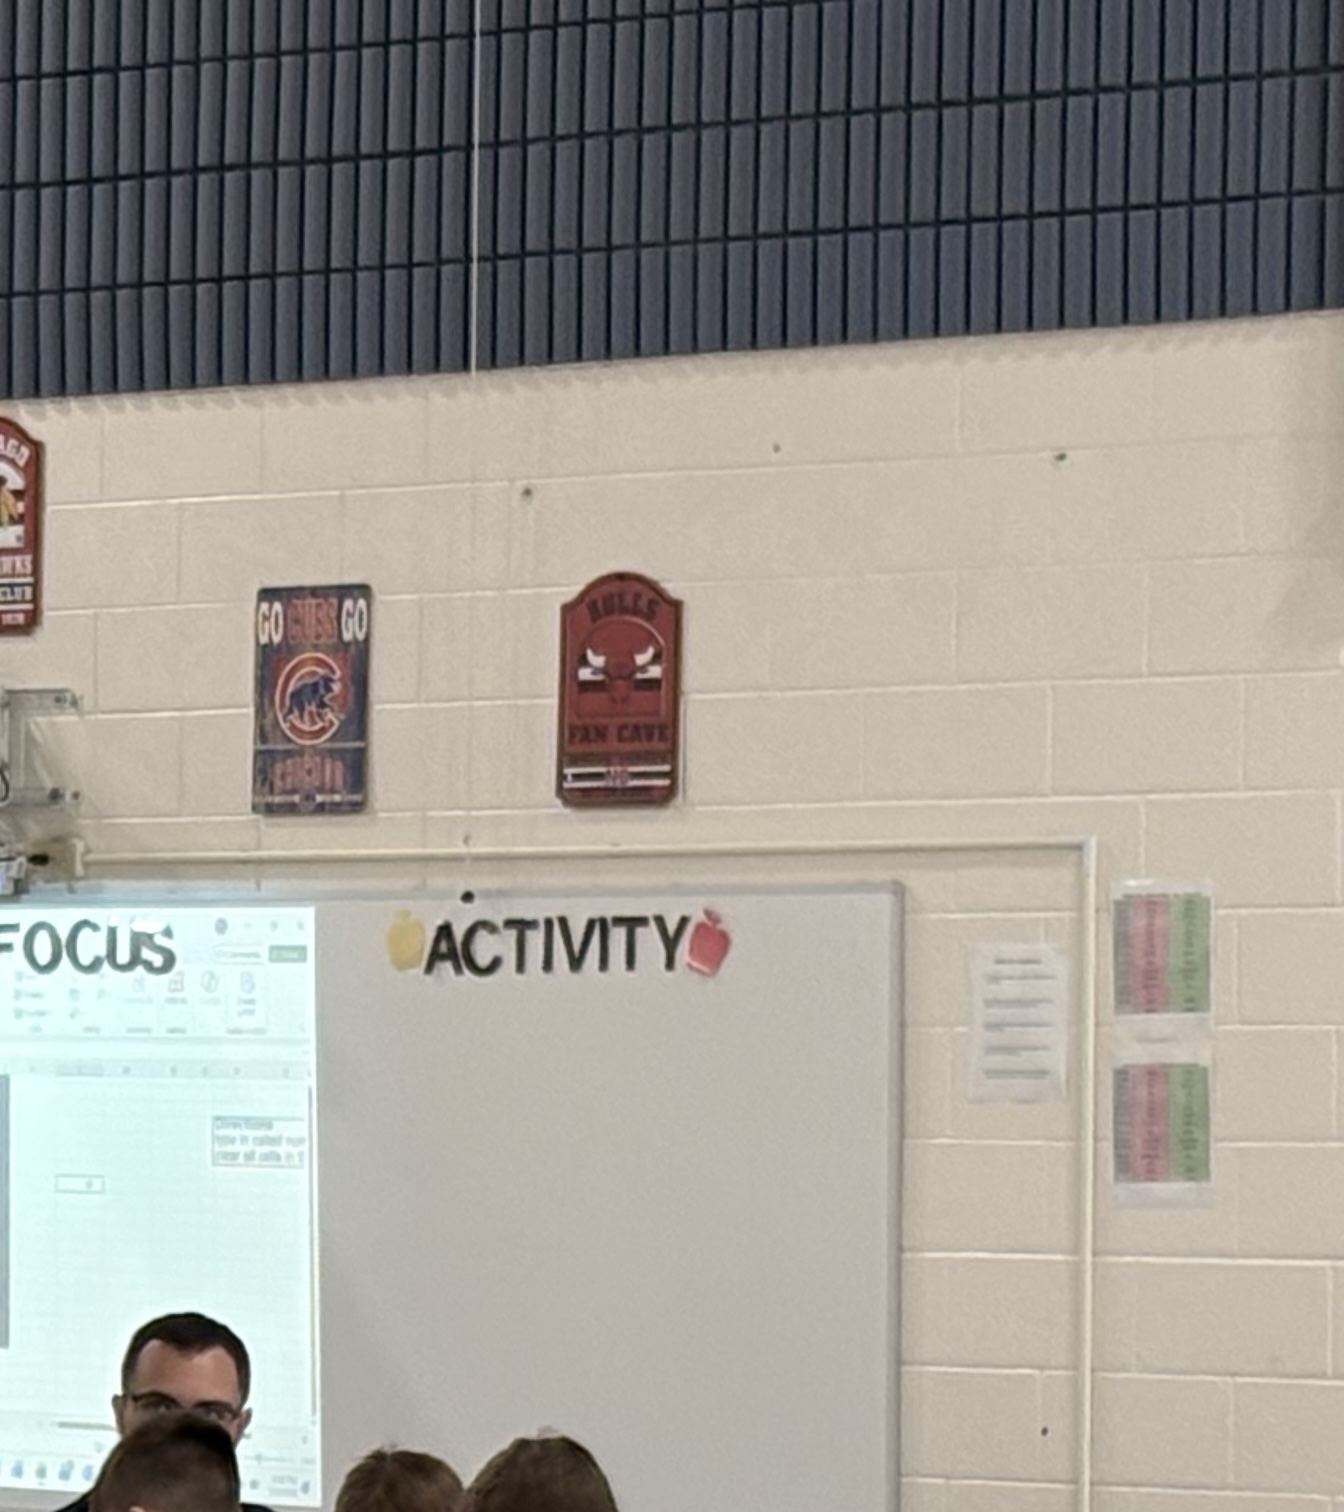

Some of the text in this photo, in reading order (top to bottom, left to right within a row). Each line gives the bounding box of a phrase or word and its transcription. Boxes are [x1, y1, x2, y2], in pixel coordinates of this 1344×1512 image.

[258, 601, 284, 644] GO
[341, 599, 367, 642] GO
[586, 591, 659, 622] BULLS
[569, 723, 669, 744] FAN CAVE
[423, 915, 691, 976] ACTIVITY
